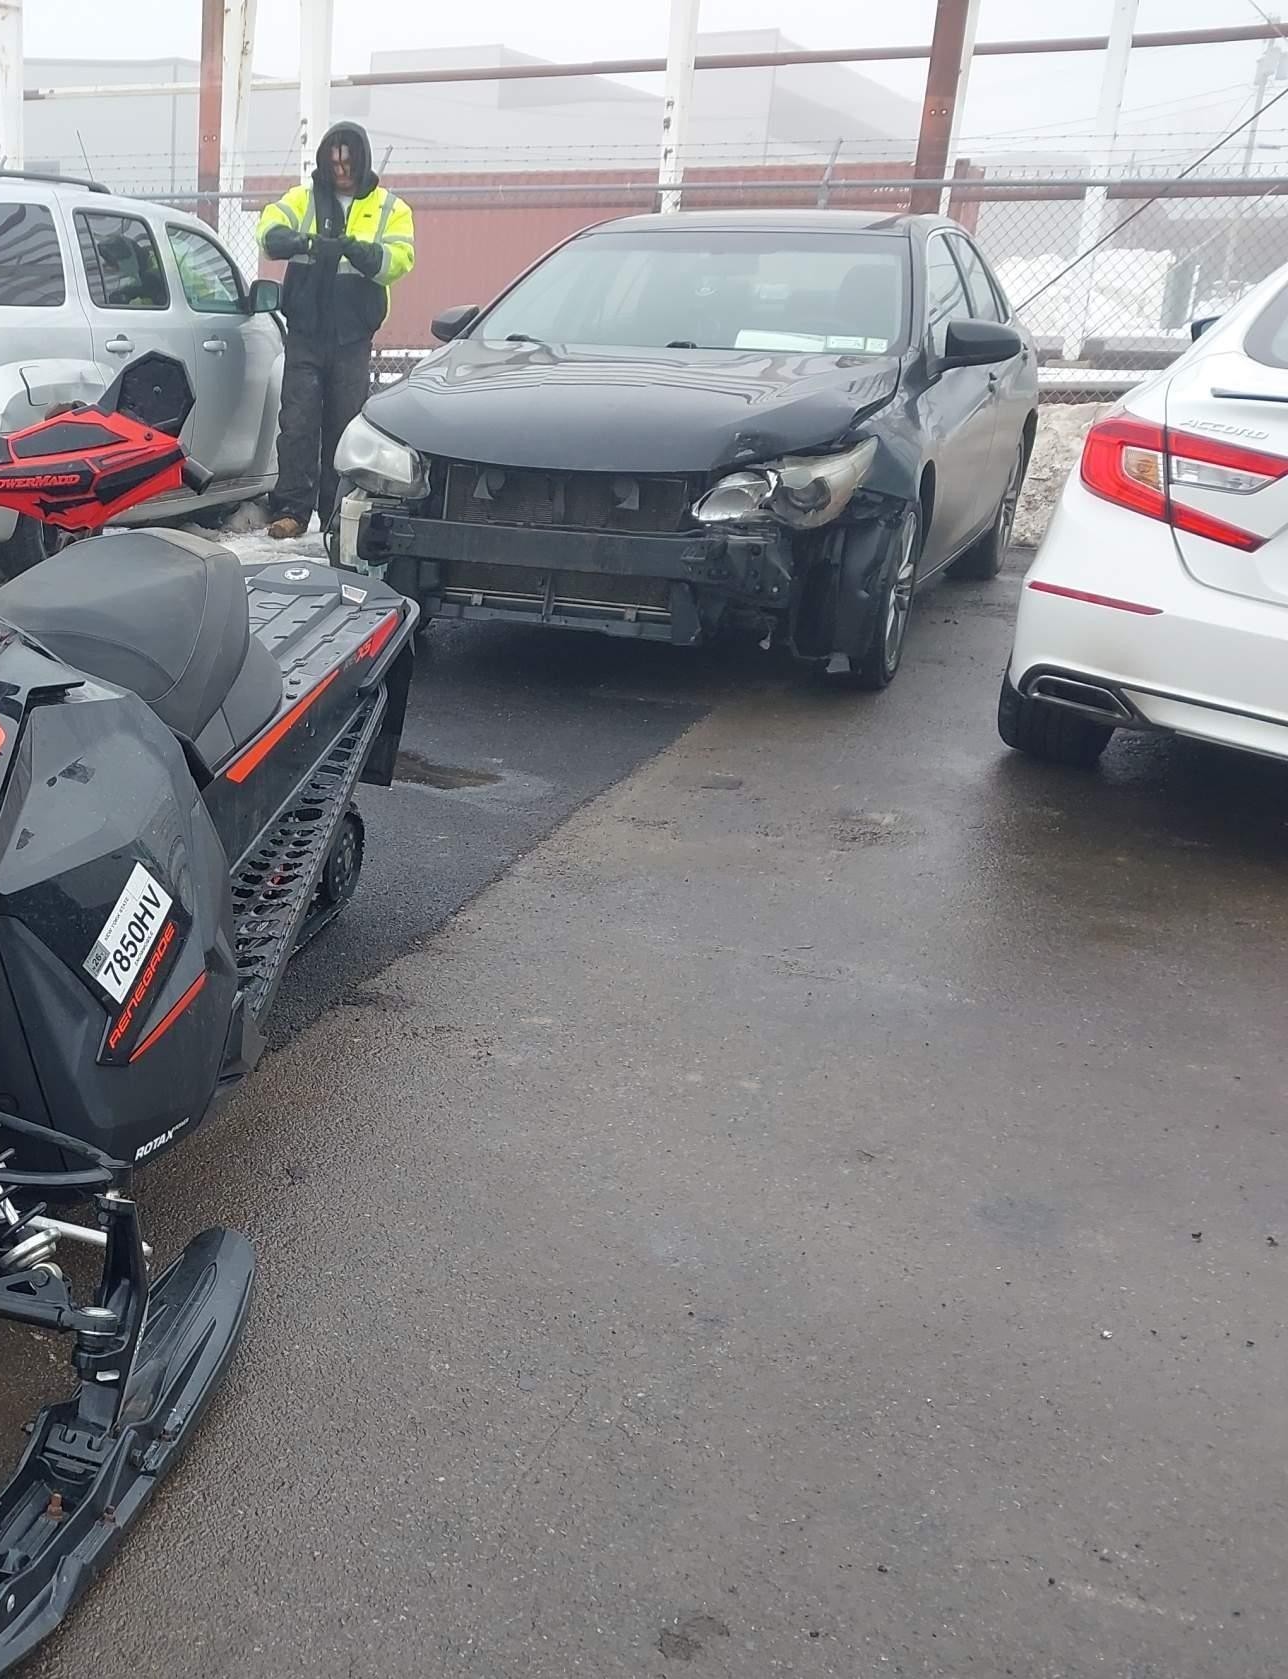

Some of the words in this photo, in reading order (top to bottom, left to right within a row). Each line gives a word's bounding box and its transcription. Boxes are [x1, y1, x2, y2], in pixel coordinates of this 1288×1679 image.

[1179, 418, 1270, 440] ACCORD
[103, 883, 161, 986] 7850HV
[108, 921, 176, 1049] RENEGADE
[134, 1130, 173, 1161] ROTAX
